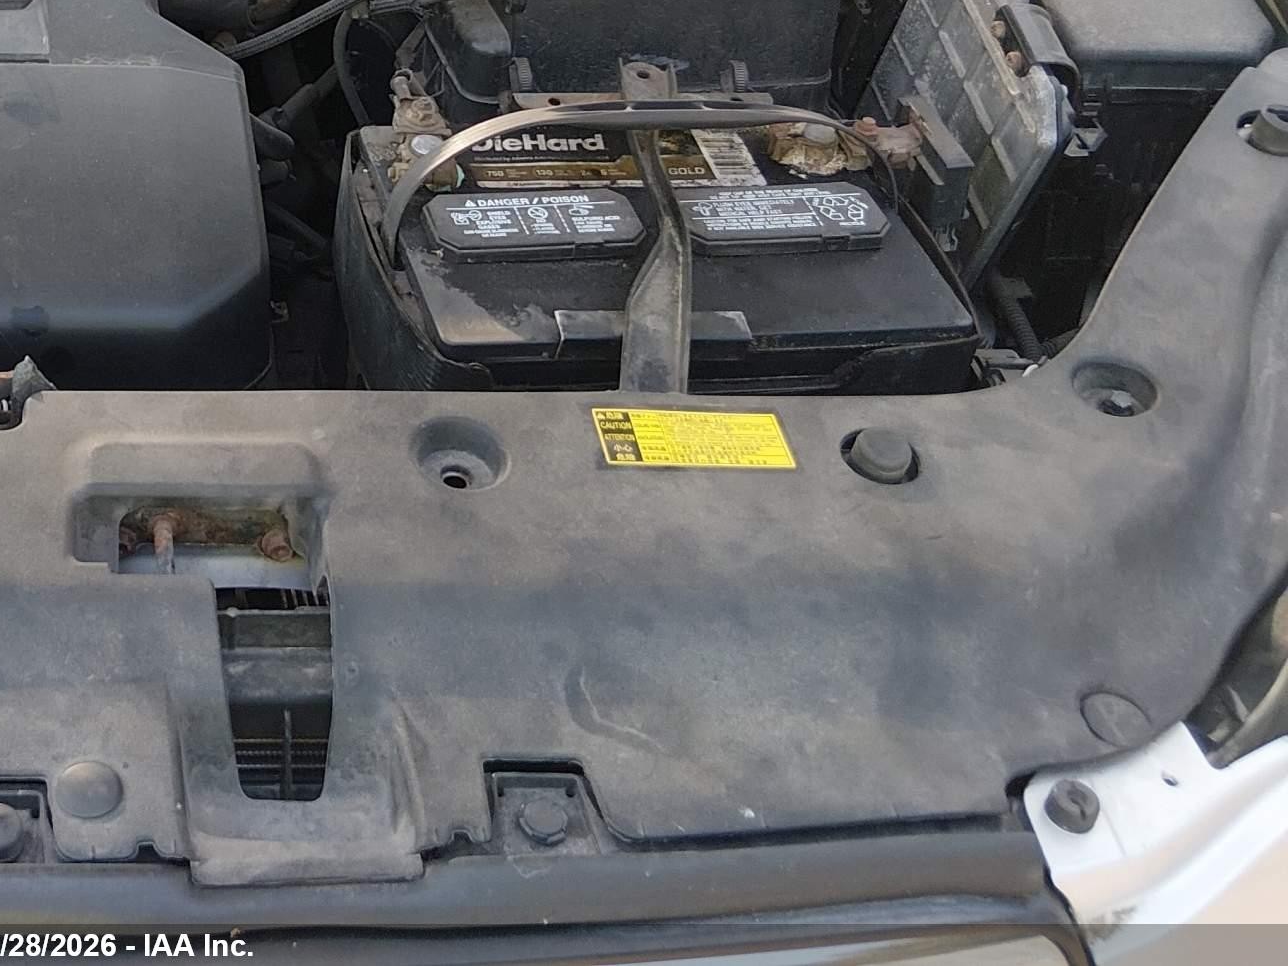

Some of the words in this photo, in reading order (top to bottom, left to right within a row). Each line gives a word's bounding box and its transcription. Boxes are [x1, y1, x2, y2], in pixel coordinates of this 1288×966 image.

[668, 167, 705, 175] GOLD
[477, 198, 530, 207] DANGER
[542, 195, 589, 204] POISON
[600, 421, 632, 430] CAUTION
